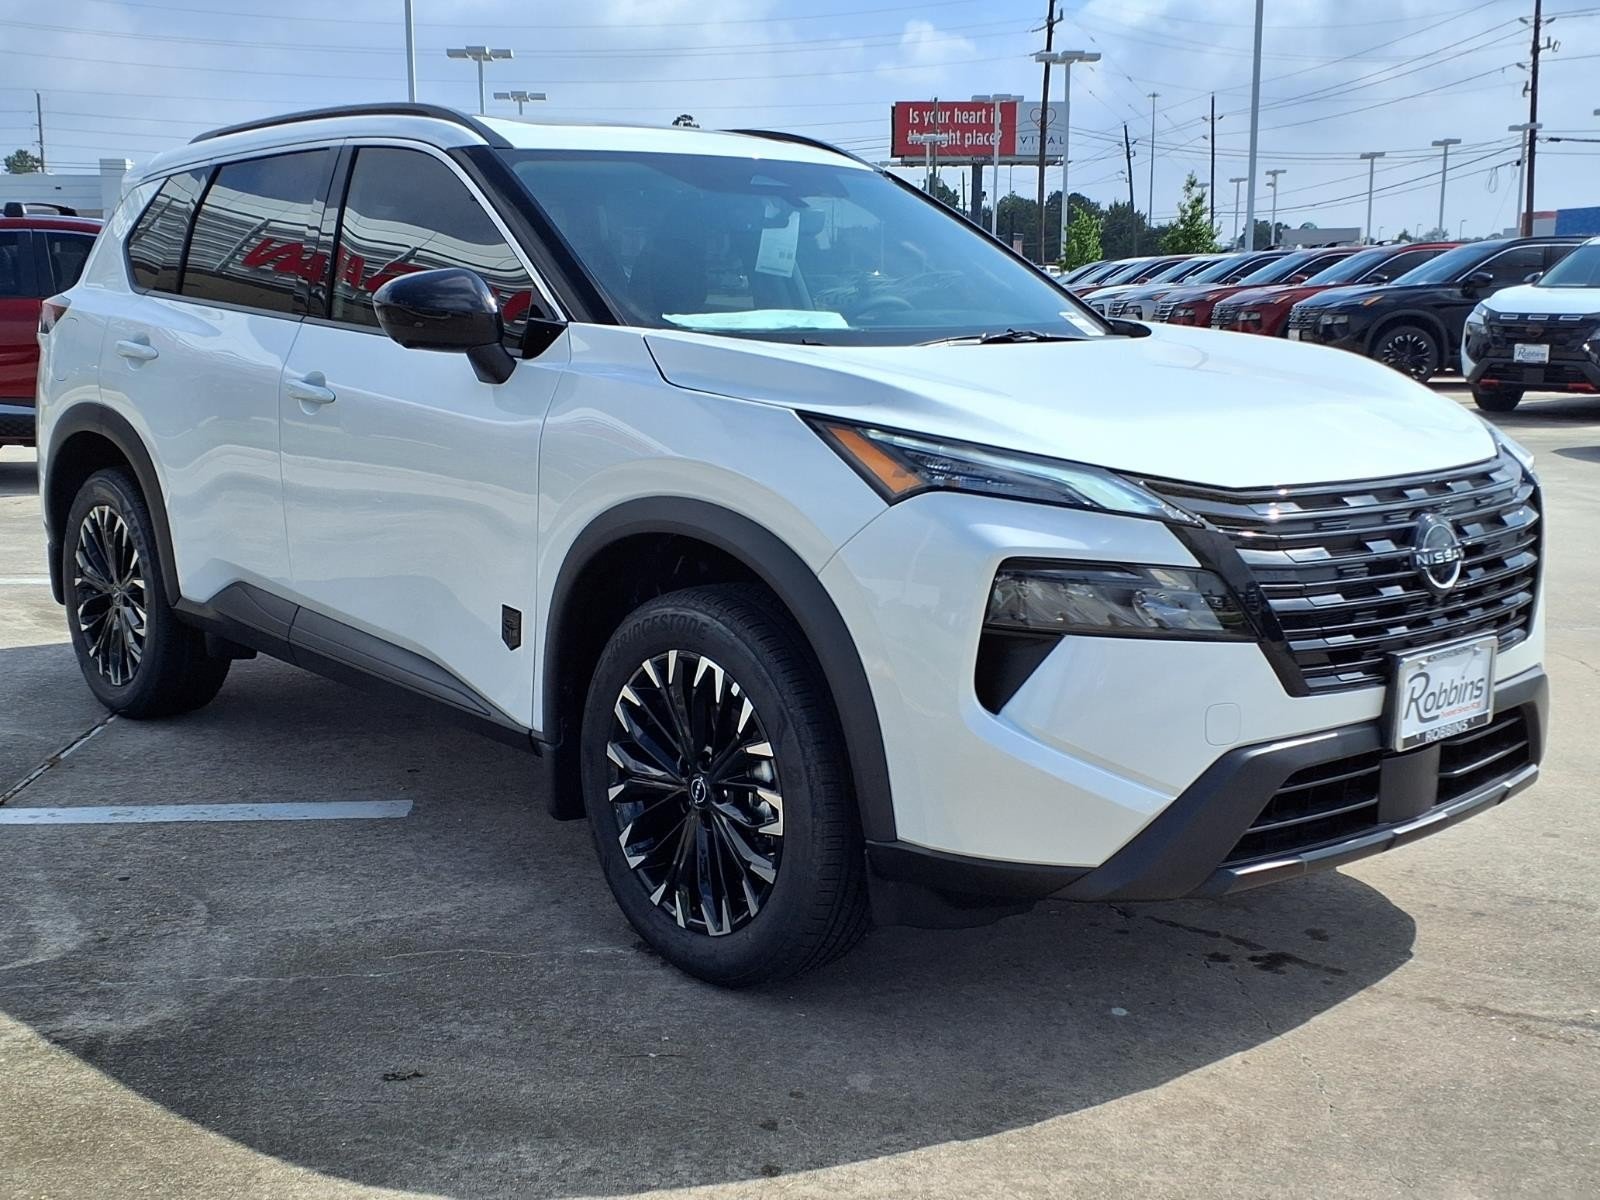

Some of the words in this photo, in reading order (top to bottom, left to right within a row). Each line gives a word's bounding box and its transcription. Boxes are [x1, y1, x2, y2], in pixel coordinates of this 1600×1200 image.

[909, 107, 920, 124] Is
[954, 107, 987, 124] heart
[1019, 136, 1064, 145] VIAL
[1403, 671, 1485, 724] Robbins
